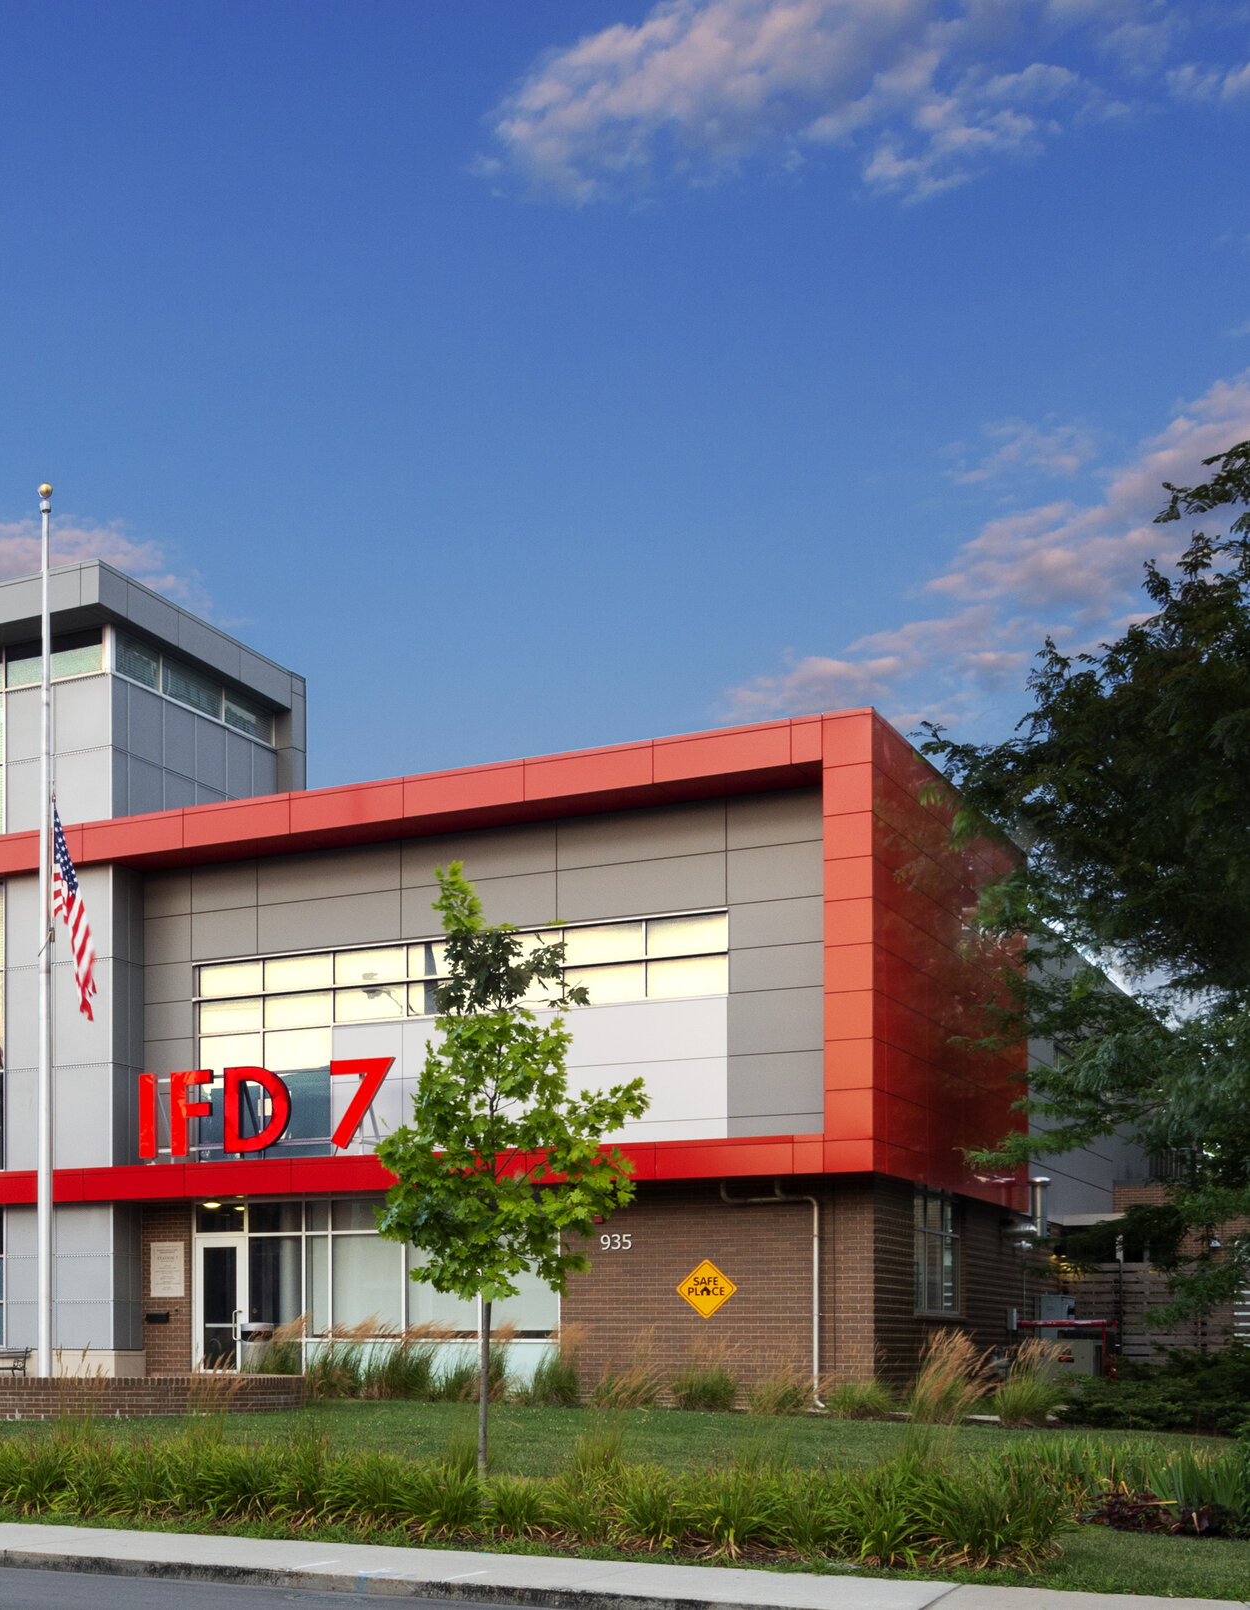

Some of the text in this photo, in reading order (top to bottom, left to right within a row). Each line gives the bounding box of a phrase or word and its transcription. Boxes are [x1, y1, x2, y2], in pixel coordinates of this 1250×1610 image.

[139, 1056, 396, 1159] IFD 7
[600, 1234, 632, 1251] 935
[693, 1276, 719, 1286] SAFE
